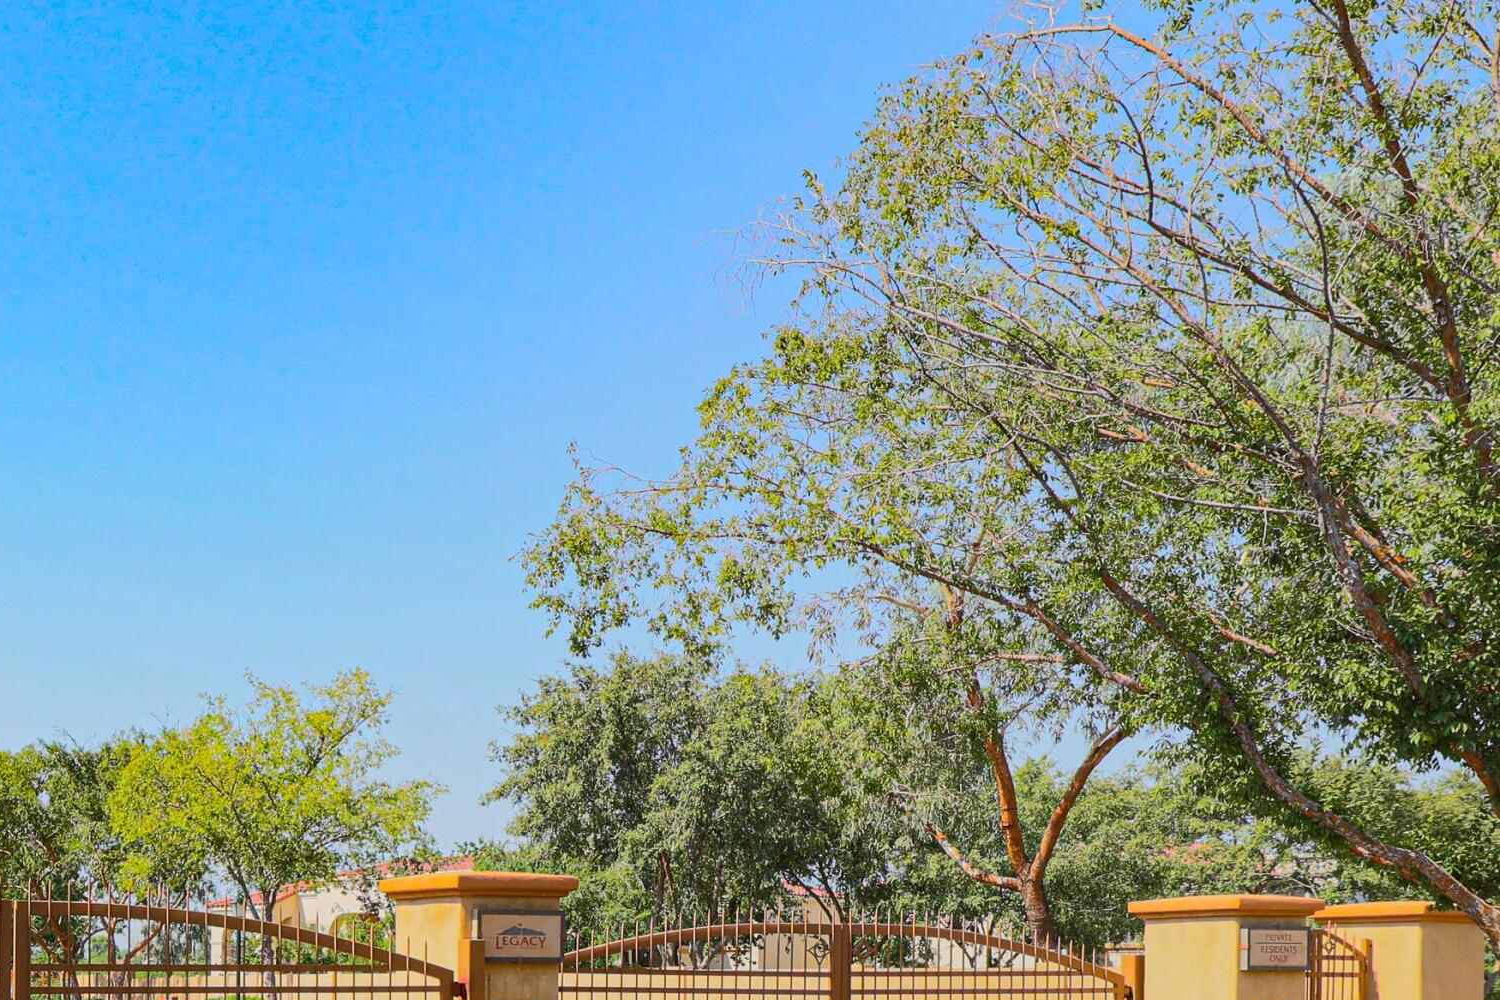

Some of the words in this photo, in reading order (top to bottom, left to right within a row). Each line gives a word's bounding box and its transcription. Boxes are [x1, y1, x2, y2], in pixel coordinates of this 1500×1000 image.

[495, 935, 547, 949] LEGACY
[1260, 945, 1297, 954] RESIDENTS
[1269, 954, 1289, 962] ONLY
